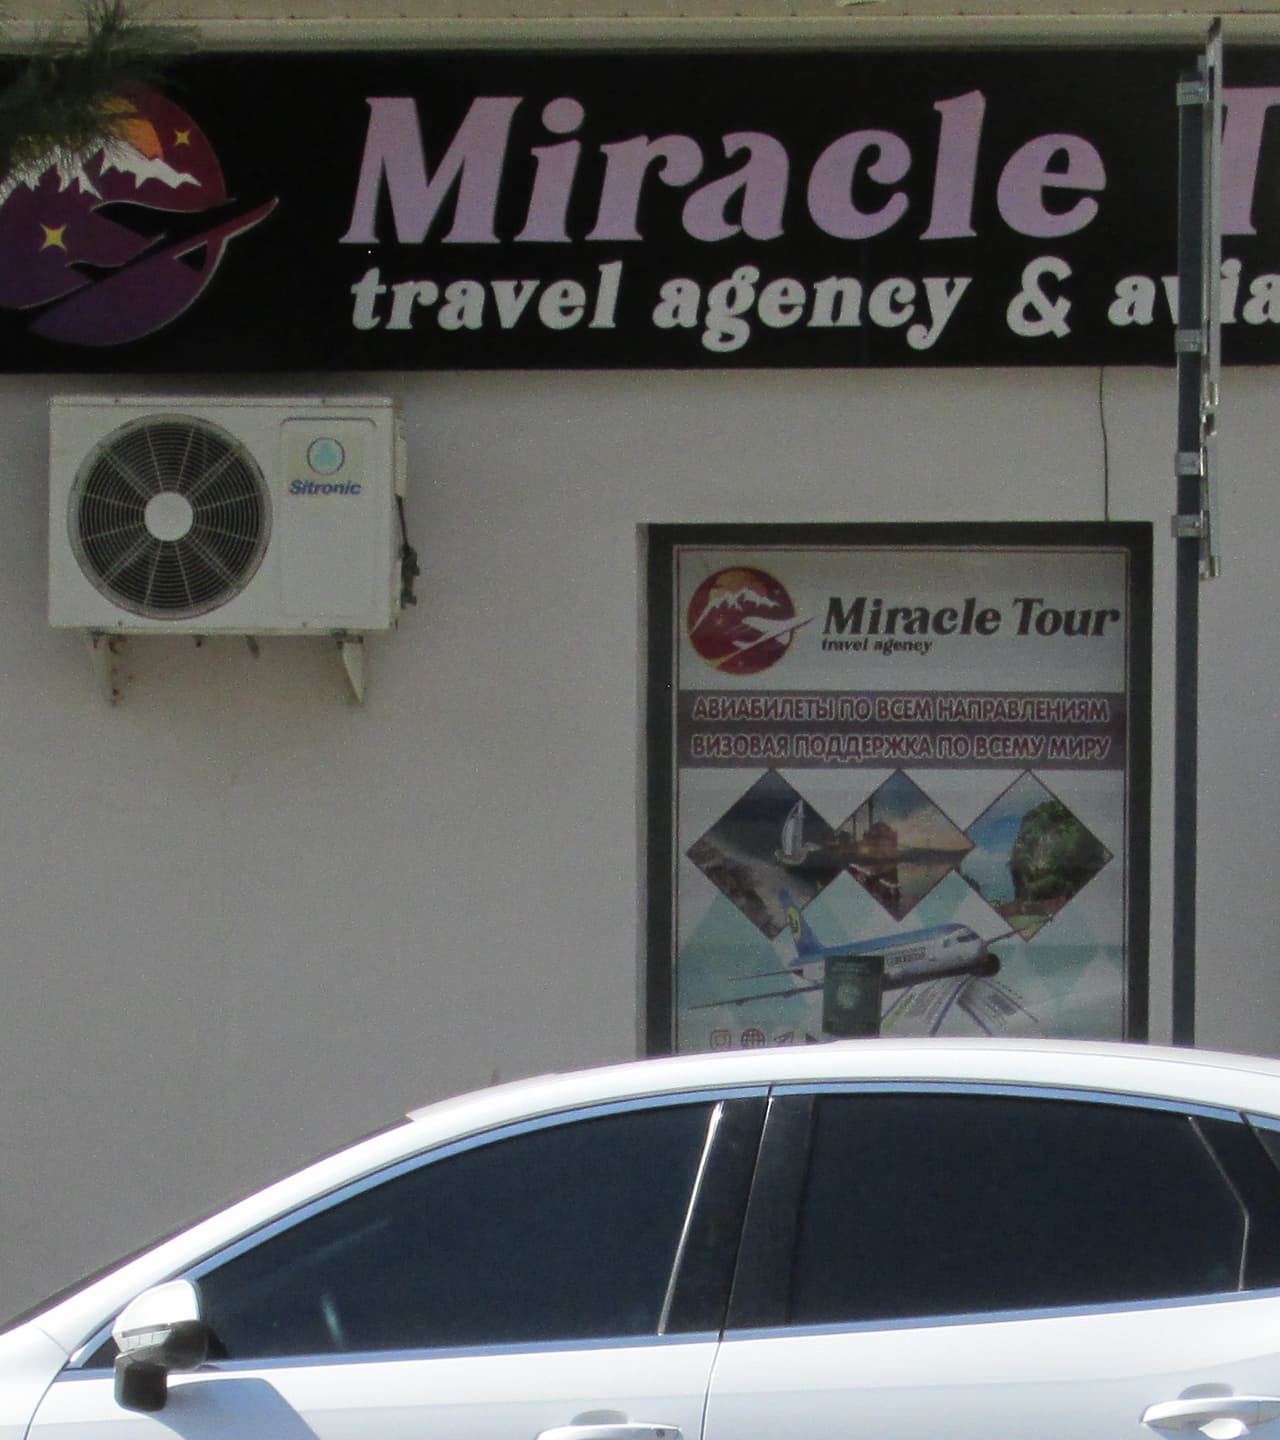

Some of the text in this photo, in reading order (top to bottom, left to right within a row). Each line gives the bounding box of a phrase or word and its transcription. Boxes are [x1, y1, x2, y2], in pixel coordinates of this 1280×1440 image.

[339, 90, 1107, 245] Miracle
[351, 262, 623, 331] travel
[652, 264, 972, 352] agency
[1006, 255, 1076, 339] &
[289, 479, 362, 496] Sitronic
[823, 597, 1120, 637] Miracle Tour
[821, 638, 933, 656] travel agency
[692, 697, 1110, 722] АВИАБИЛЕТЫ ПО ВСЕМ НАПРАВЛЕНИЯМ
[691, 734, 1111, 762] ВИЗОВАЯ ПОДДЕРЖКА ПО ВСЕМУ МИРУ
